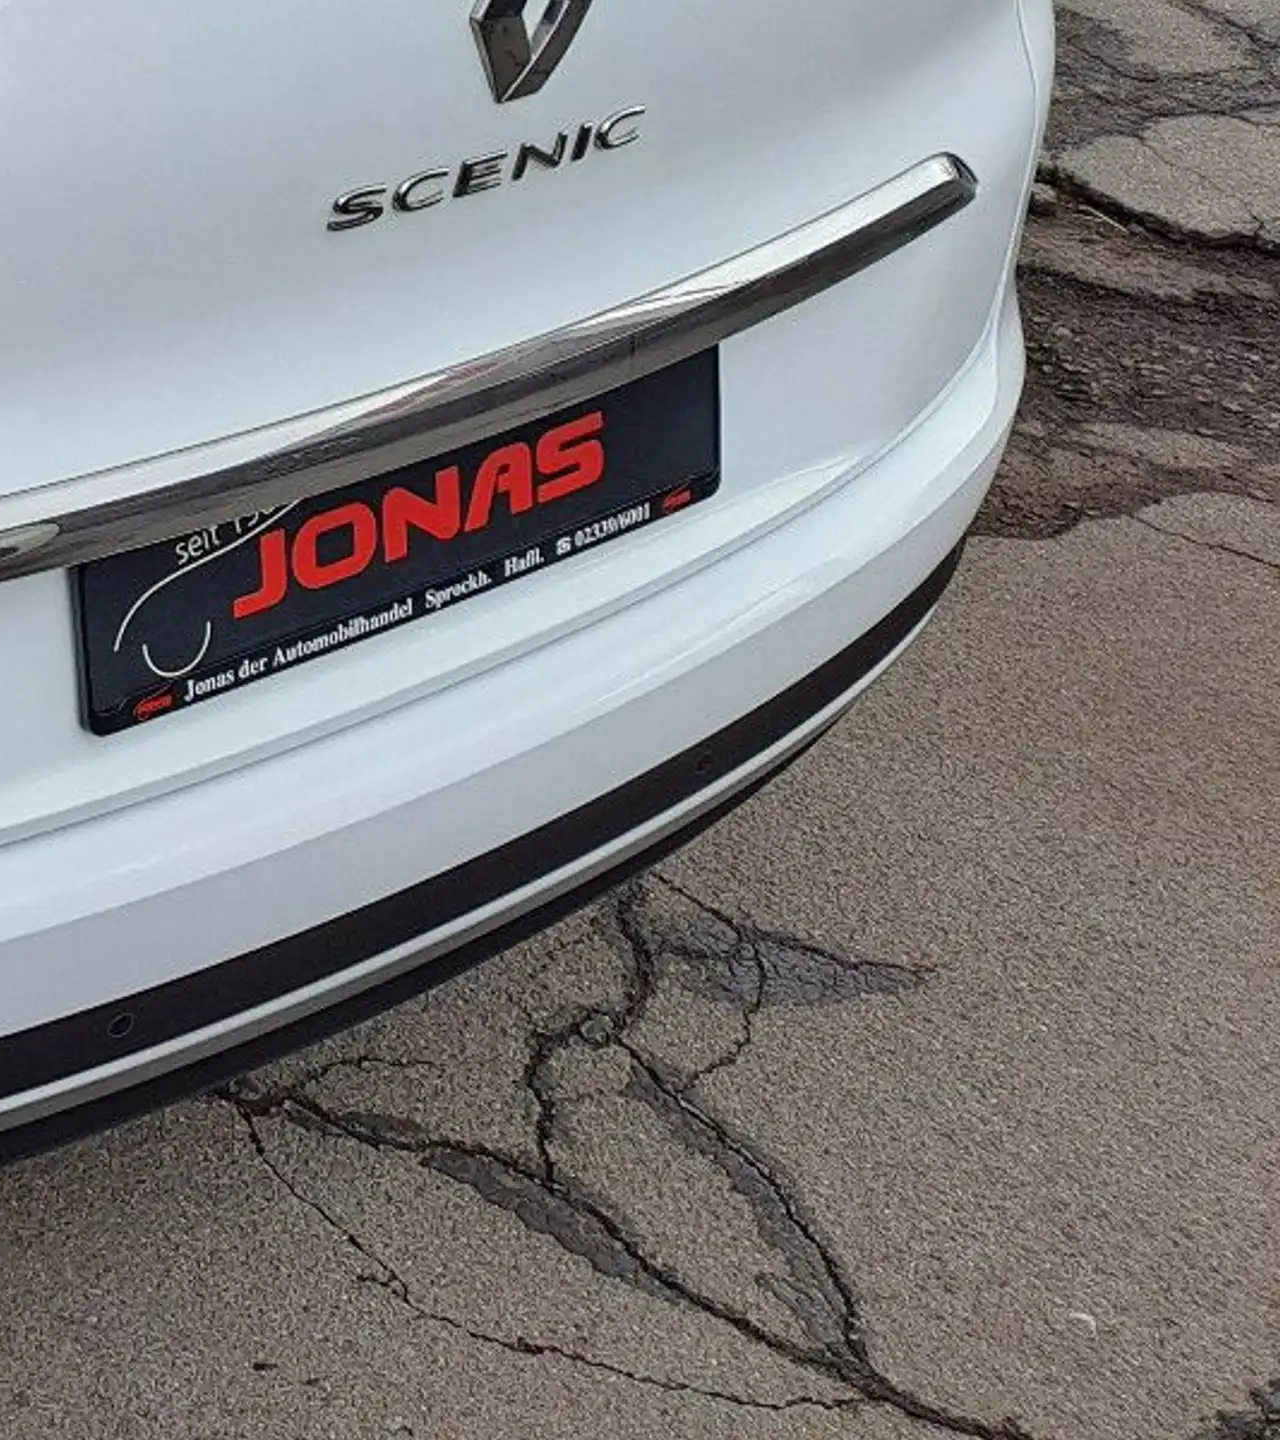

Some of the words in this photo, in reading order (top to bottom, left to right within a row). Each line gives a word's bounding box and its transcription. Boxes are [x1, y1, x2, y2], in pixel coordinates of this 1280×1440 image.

[326, 103, 647, 232] SCENIC
[232, 410, 605, 620] JONAS
[184, 668, 235, 702] Jonas
[237, 654, 269, 679] der
[272, 597, 414, 667] Automobilhandel
